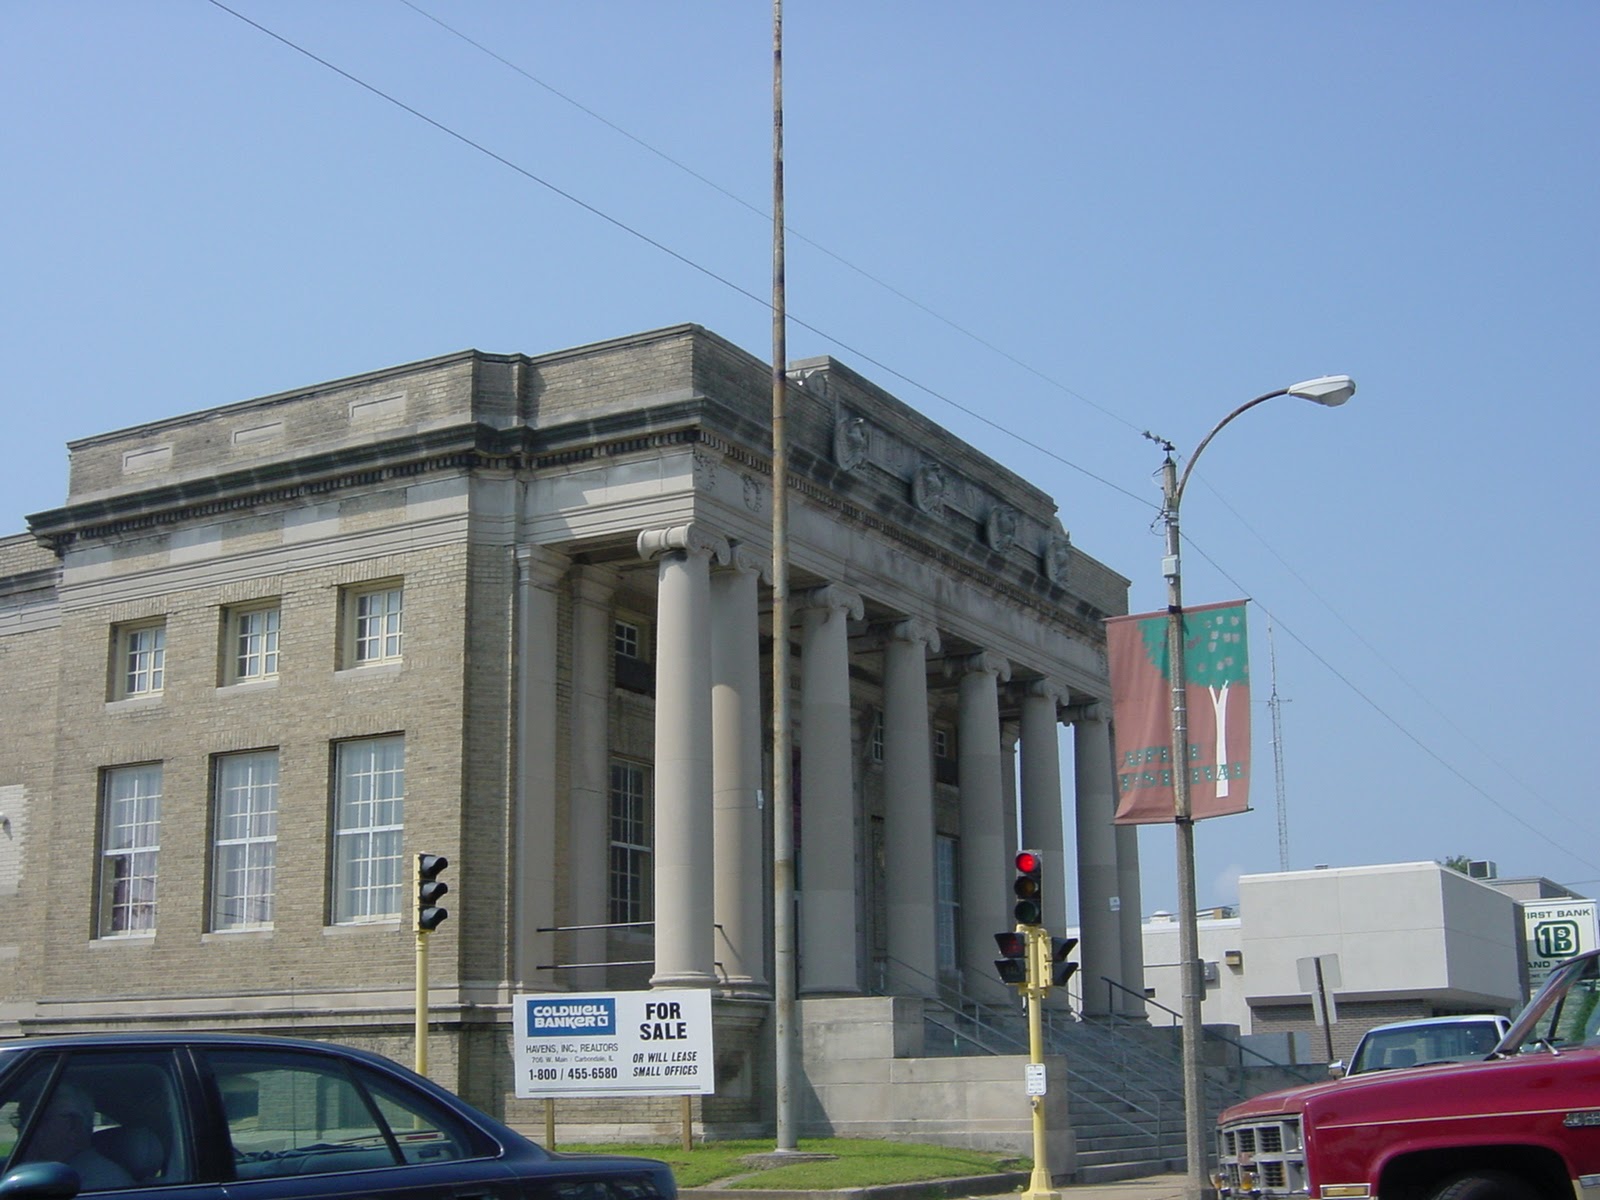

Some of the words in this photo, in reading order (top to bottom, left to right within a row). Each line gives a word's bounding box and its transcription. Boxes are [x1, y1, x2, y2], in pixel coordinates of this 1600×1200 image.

[1524, 911, 1553, 919] IRST
[1557, 909, 1591, 917] BANK
[533, 1004, 609, 1016] COLDWELL
[645, 1002, 681, 1020] FOR
[534, 1016, 596, 1029] BANKER
[639, 1022, 688, 1041] SALE
[525, 1044, 558, 1054] HAVENS,
[580, 1042, 619, 1052] REALTORS
[632, 1053, 646, 1063] OR
[648, 1052, 667, 1063] WILL
[671, 1051, 698, 1062] LEASE
[529, 1068, 557, 1080] 1-800
[567, 1067, 618, 1080] 455-6580
[632, 1066, 661, 1077] SMALL
[665, 1065, 698, 1076] OFFICES
